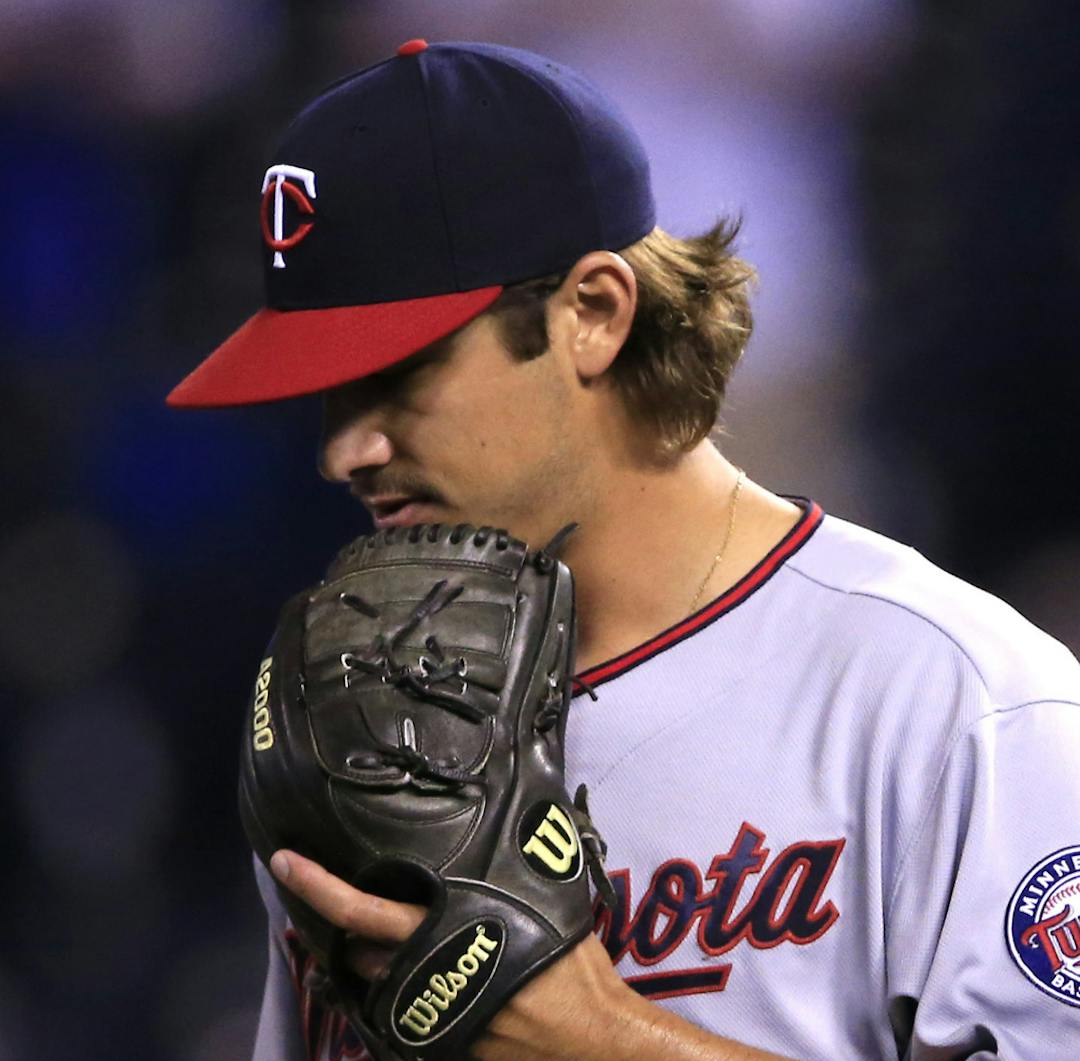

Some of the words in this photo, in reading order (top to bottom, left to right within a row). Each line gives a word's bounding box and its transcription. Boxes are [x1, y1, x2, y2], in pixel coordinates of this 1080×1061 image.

[252, 655, 275, 752] A2000
[520, 803, 582, 875] W
[400, 928, 499, 1036] Wilson
